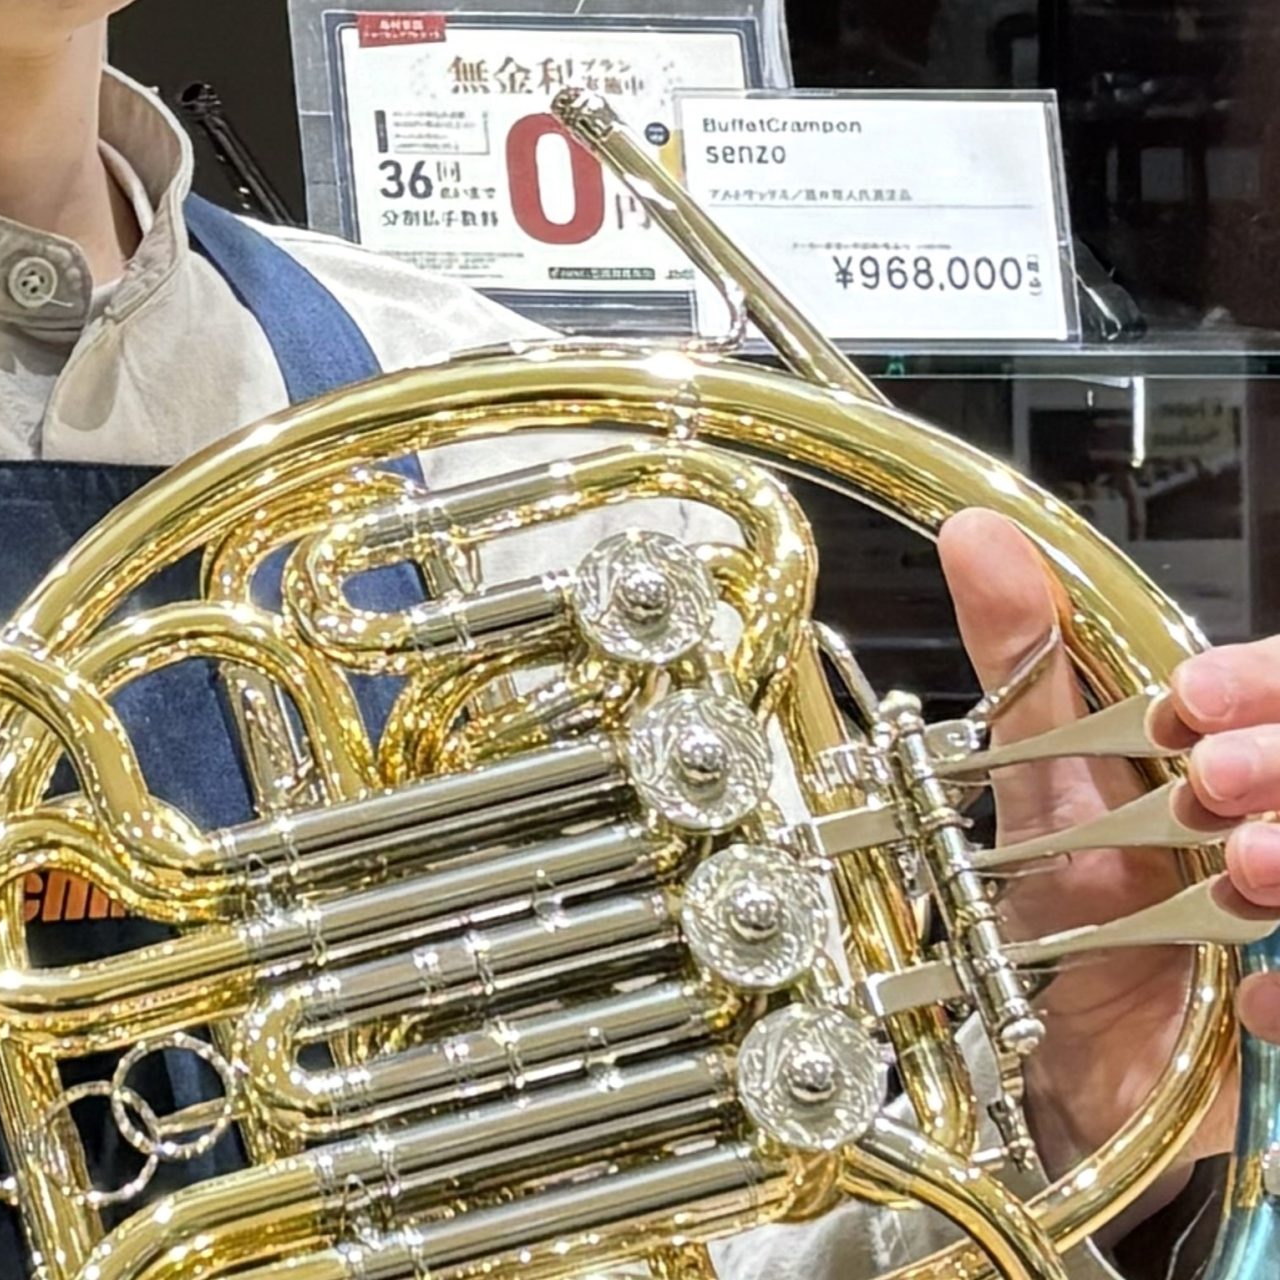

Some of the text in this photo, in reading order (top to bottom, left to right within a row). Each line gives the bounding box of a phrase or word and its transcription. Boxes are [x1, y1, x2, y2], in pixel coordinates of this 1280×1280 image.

[448, 55, 573, 95] 無金利
[706, 145, 787, 164] senzo
